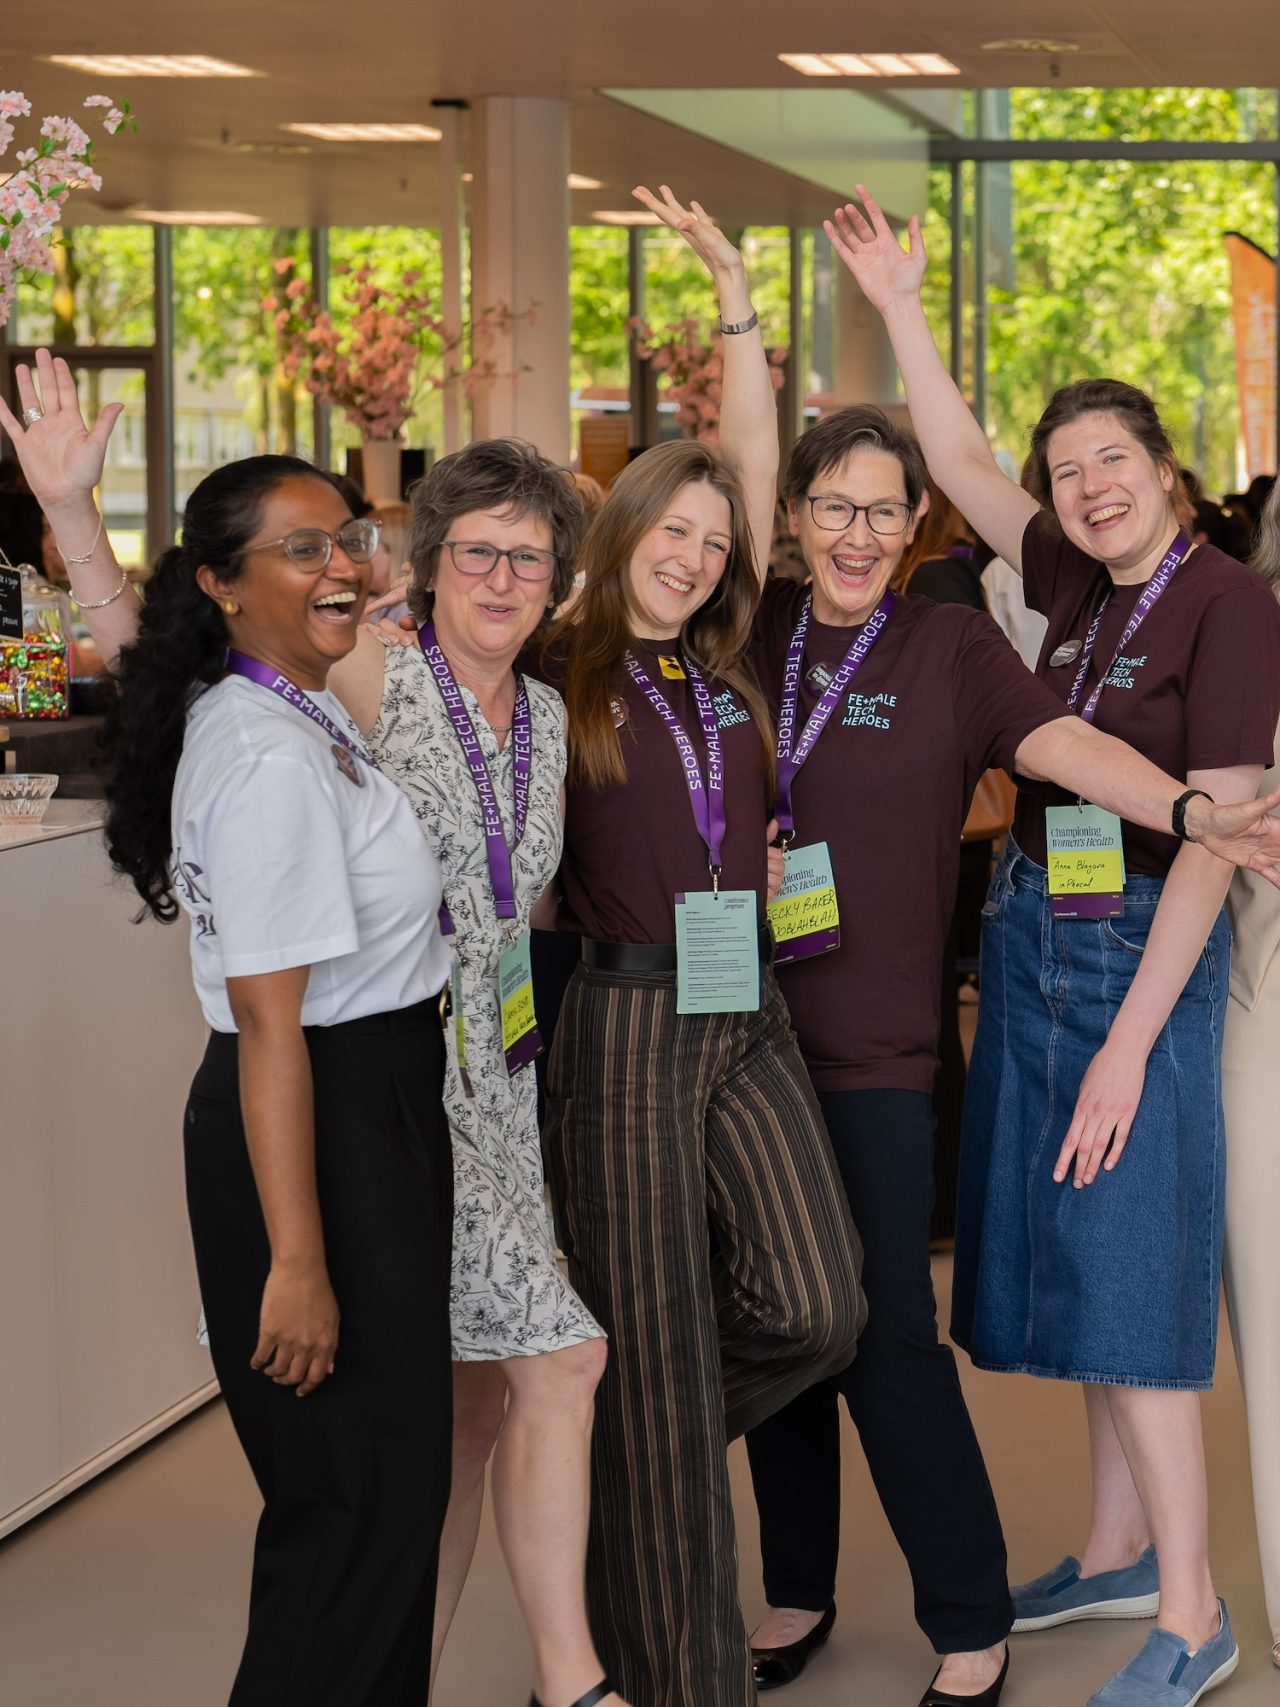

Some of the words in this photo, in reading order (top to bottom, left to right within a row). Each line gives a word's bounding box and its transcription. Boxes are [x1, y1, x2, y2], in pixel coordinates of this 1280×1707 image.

[1139, 552, 1181, 610] FE+MALE
[790, 594, 812, 649] FE+MALE
[1118, 613, 1144, 650] TECH
[424, 645, 462, 708] HEROES
[784, 654, 801, 692] TECH
[1067, 655, 1089, 708] E+MALE
[1084, 617, 1101, 654] TECH
[1111, 667, 1131, 677] TECH
[693, 682, 713, 718] TECH
[791, 702, 832, 765] FE+MALE
[824, 665, 855, 697] TECH
[847, 609, 887, 663] HEROES
[848, 693, 898, 707] FE+MALE
[271, 675, 340, 738] FE+MALE
[715, 703, 737, 717] ECH
[842, 715, 891, 730] HEROES
[847, 704, 876, 716] TECH
[452, 714, 480, 757] TECH
[514, 723, 530, 762] TECH
[644, 686, 675, 720] TECH
[669, 725, 702, 790] HEROES
[776, 698, 795, 758] HEROES
[703, 724, 722, 790] FE+MALE
[471, 762, 502, 836] FE+MALE
[514, 771, 529, 841] FE+MALE
[1050, 826, 1102, 839] Championing
[1052, 838, 1085, 848] Women's
[1086, 836, 1114, 848] Health
[779, 883, 799, 896] en's
[799, 875, 829, 892] Health
[782, 868, 815, 886] pioning
[802, 890, 836, 914] BAKER
